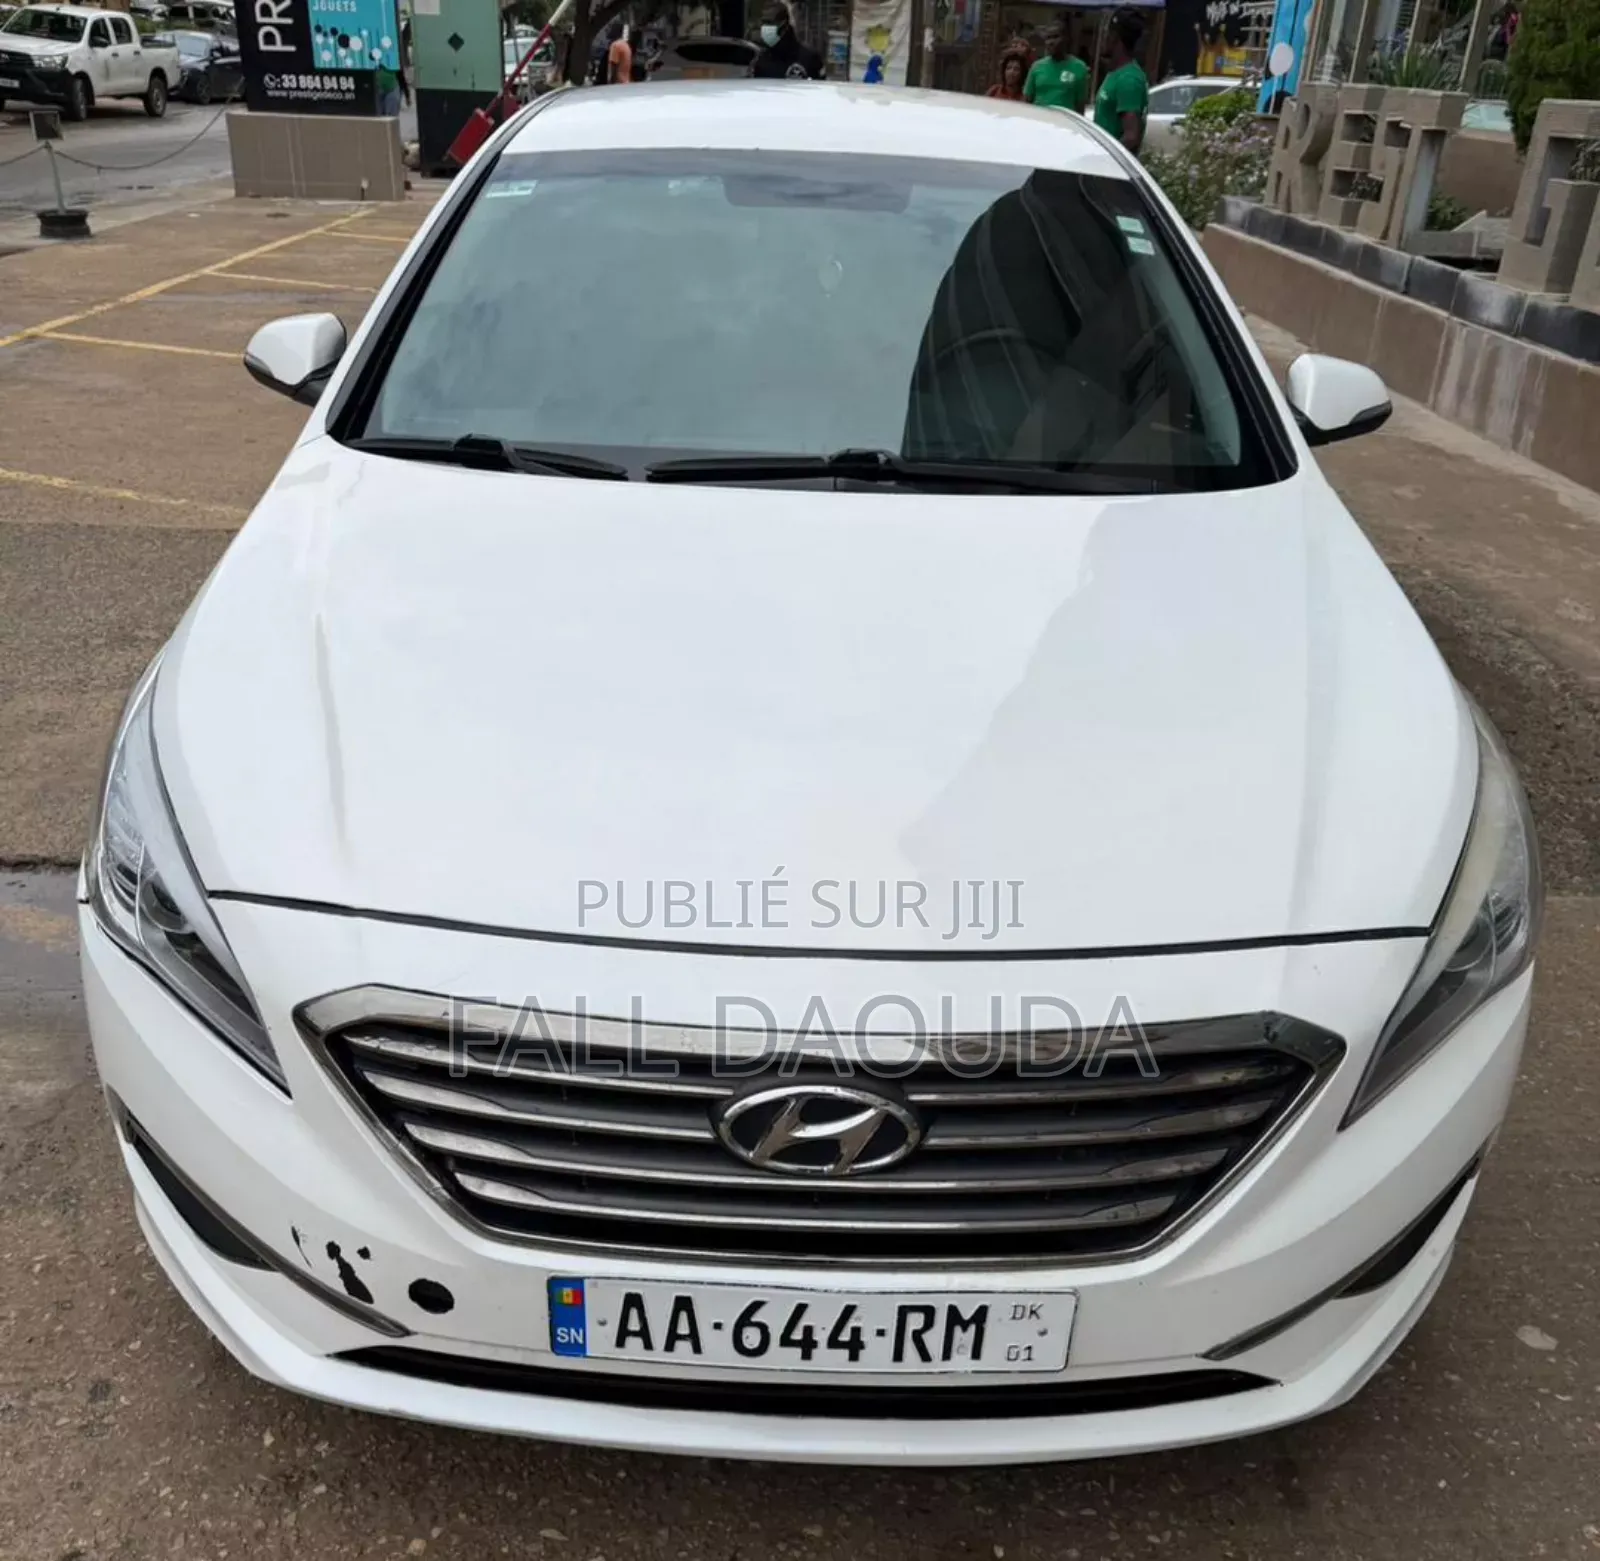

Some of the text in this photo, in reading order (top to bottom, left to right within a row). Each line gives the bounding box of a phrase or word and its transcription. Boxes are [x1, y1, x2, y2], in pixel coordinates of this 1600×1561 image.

[312, 0, 357, 12] JOUETS
[1010, 1303, 1044, 1321] DK
[556, 1327, 585, 1345] SN
